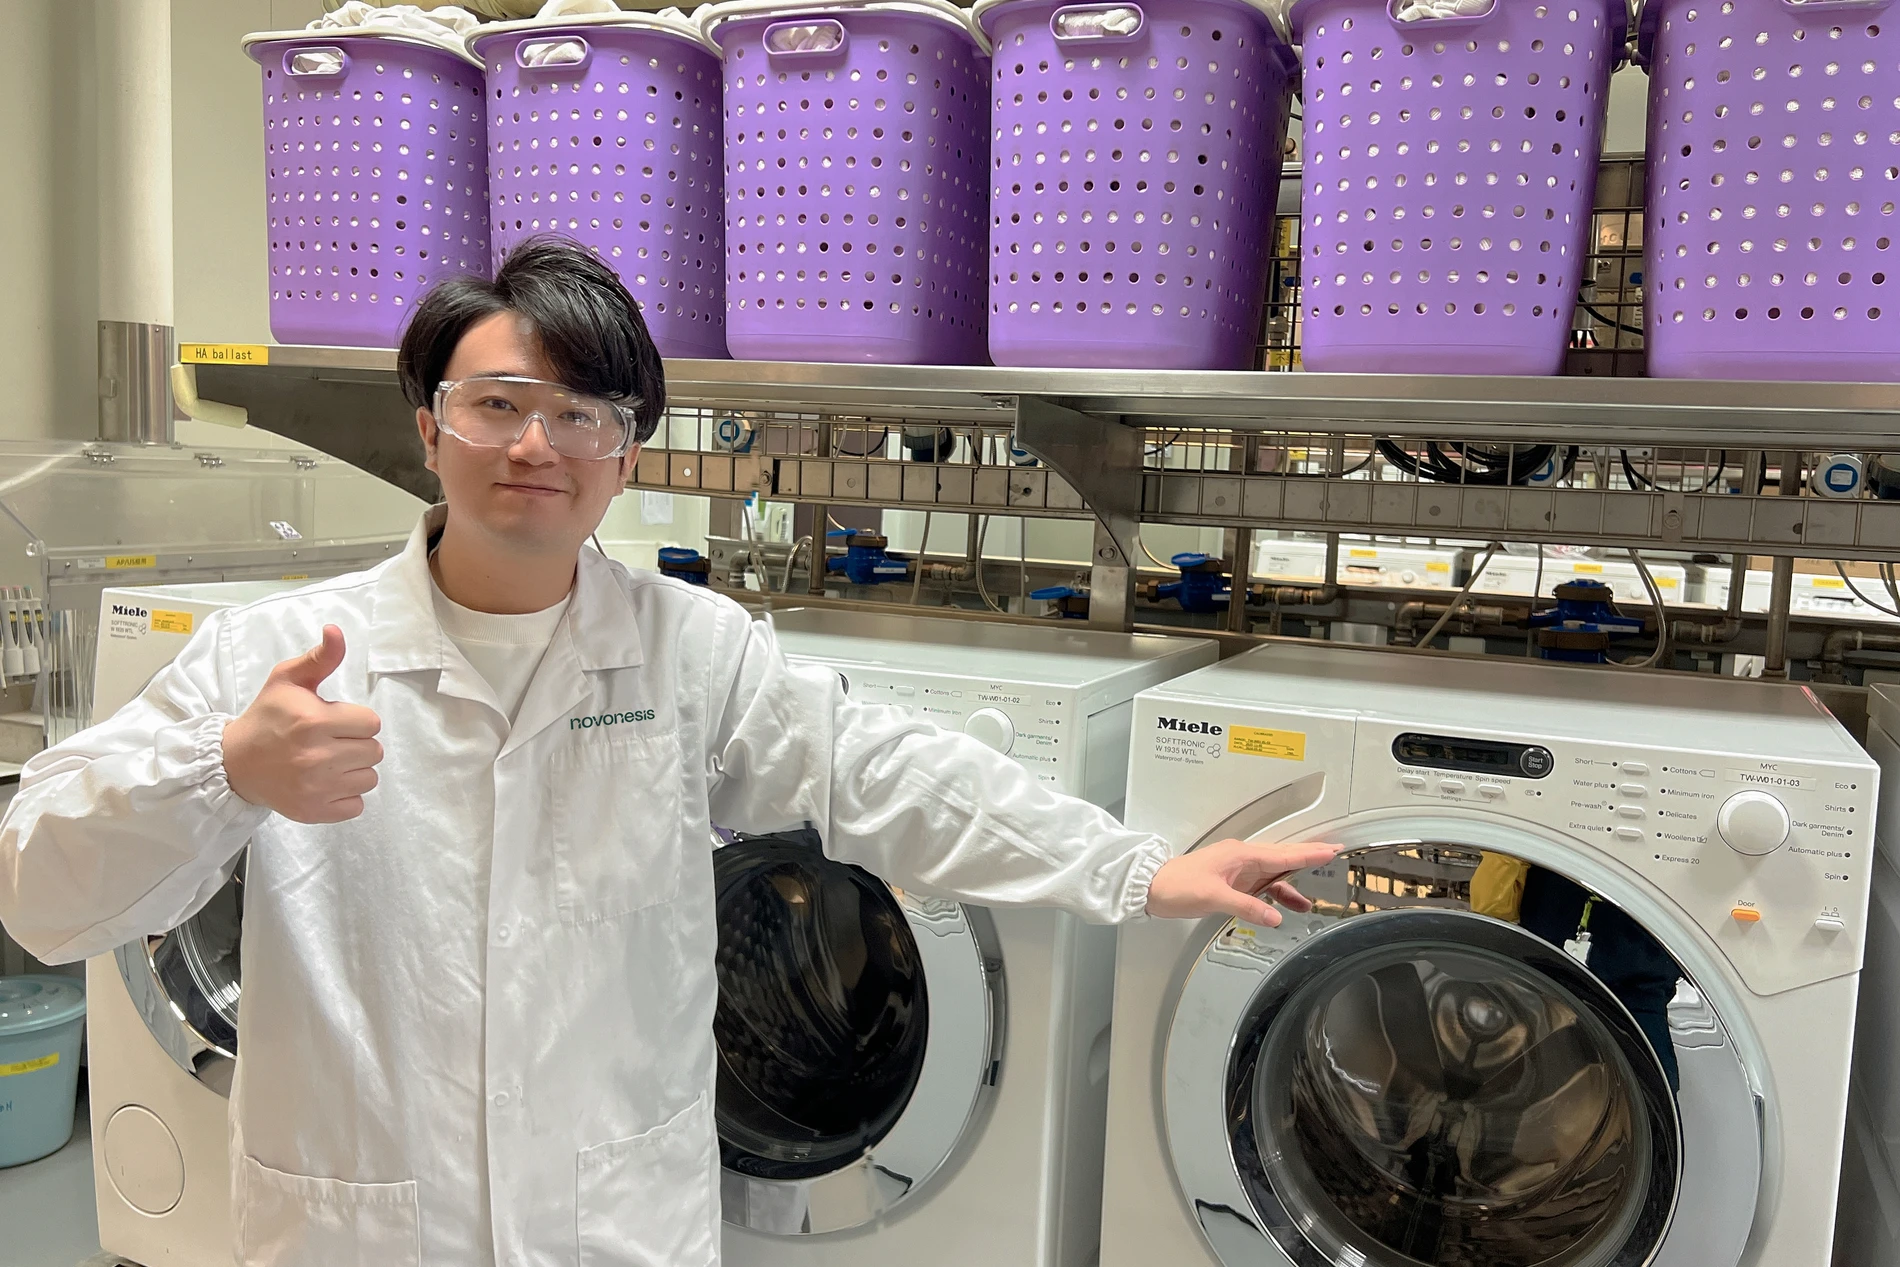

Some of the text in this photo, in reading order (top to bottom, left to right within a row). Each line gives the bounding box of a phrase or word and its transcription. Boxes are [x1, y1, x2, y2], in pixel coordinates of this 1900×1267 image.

[196, 348, 252, 360] HA ballast
[112, 604, 147, 617] Miele
[978, 694, 1020, 703] TW-W01-01-02
[570, 709, 655, 730] novonesis
[1157, 717, 1222, 736] Miele
[1156, 737, 1205, 748] SOFTTRONIC
[1670, 767, 1697, 775] Cottons
[1760, 763, 1778, 771] MYC
[1433, 770, 1473, 781] Temperature
[1740, 774, 1800, 787] TW-W01-01-03
[1667, 789, 1700, 798] Minimum
[1570, 801, 1602, 809] Pre-wash
[1824, 804, 1846, 813] Shirts
[1666, 811, 1697, 820] Delicates
[1664, 833, 1696, 842] Woollens
[1788, 846, 1842, 858] Automatic plus
[1662, 855, 1689, 863] Express
